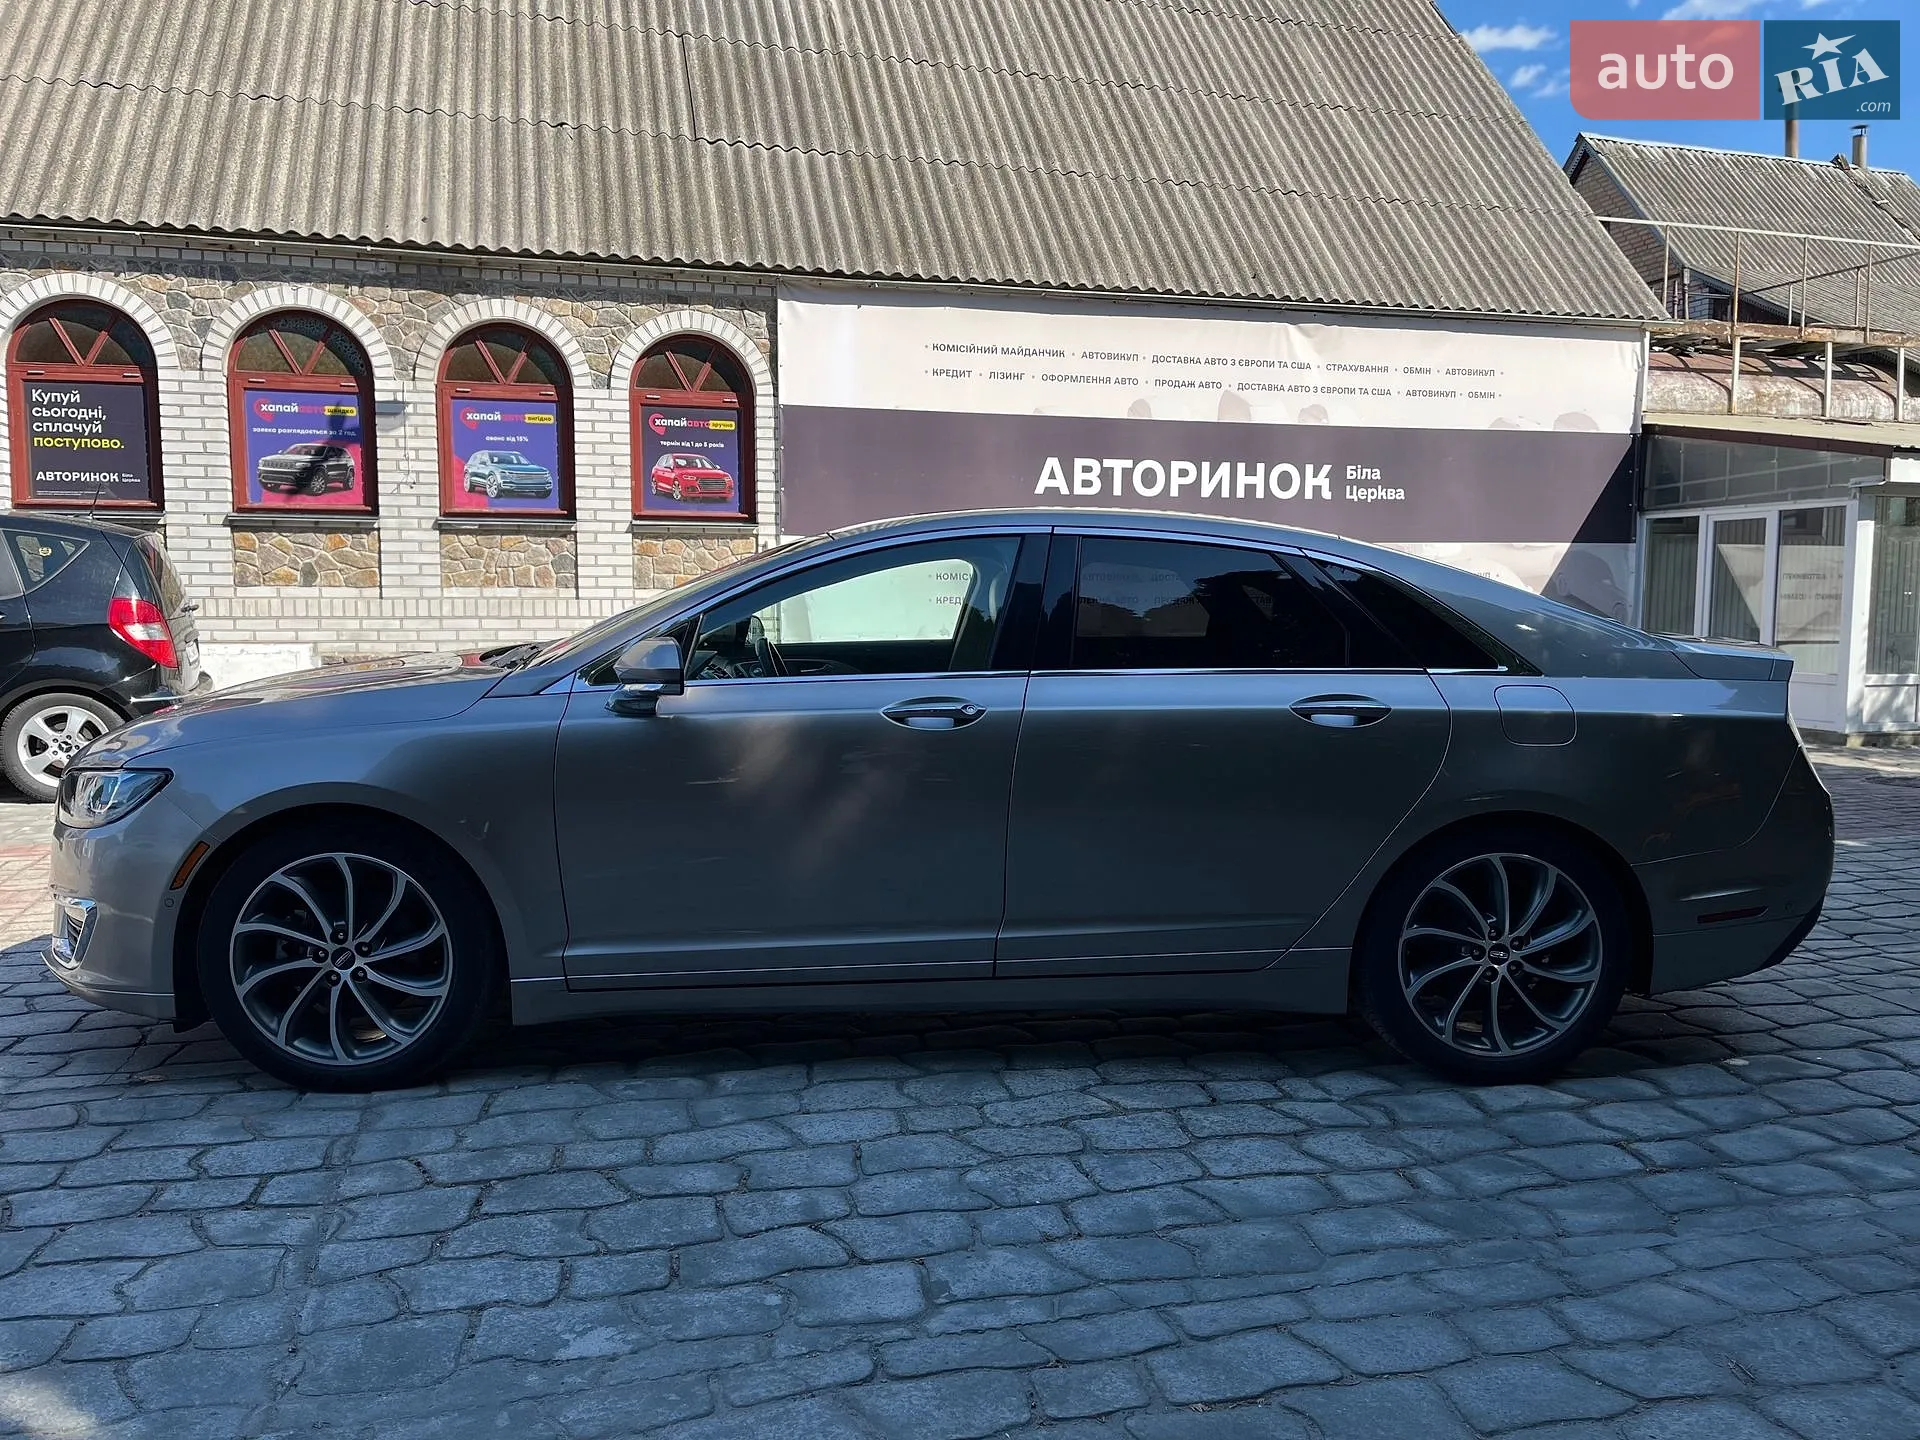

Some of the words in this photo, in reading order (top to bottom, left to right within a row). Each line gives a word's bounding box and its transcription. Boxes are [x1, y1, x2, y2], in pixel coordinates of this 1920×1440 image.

[932, 343, 998, 355] КОМІСІЙНИЙ
[1000, 346, 1065, 358] МАЙДАНЧИК
[1081, 351, 1139, 362] АВТОВИКУП
[1151, 355, 1202, 365] ДОСТАВКА
[1203, 357, 1228, 367] АВТО
[1230, 358, 1236, 367] З
[1238, 359, 1276, 369] ЄВРОПИ
[1277, 360, 1289, 369] ТА
[1290, 361, 1312, 371] США
[1325, 363, 1389, 374] СТРАХУВАННЯ
[1402, 366, 1432, 376] ОБМІН
[932, 367, 973, 379] КРЕДИТ
[988, 371, 1026, 381] ЛІЗИНГ
[1041, 373, 1112, 385] ОФОРМЛЕННЯ
[1113, 377, 1139, 386] АВТО
[1154, 379, 1196, 390] ПРОДАЖ
[1198, 381, 1223, 390] АВТО
[1237, 382, 1286, 393] ДОСТАВКА
[1287, 385, 1311, 393] АВТО
[1312, 385, 1319, 394] З
[1320, 386, 1356, 395] ЄВРОПИ
[1358, 387, 1370, 396] ТА
[1371, 387, 1392, 397] США
[1467, 391, 1496, 399] ОБМІН
[31, 388, 81, 406] Купуй
[31, 405, 107, 421] сьогодні,
[32, 420, 103, 436] сплачуй
[33, 436, 125, 451] поступово.
[36, 471, 120, 483] АВТОРИНОК
[1034, 456, 1333, 500] АВТОРИНОК
[1345, 464, 1382, 481] Біла
[1345, 484, 1406, 503] Церква
